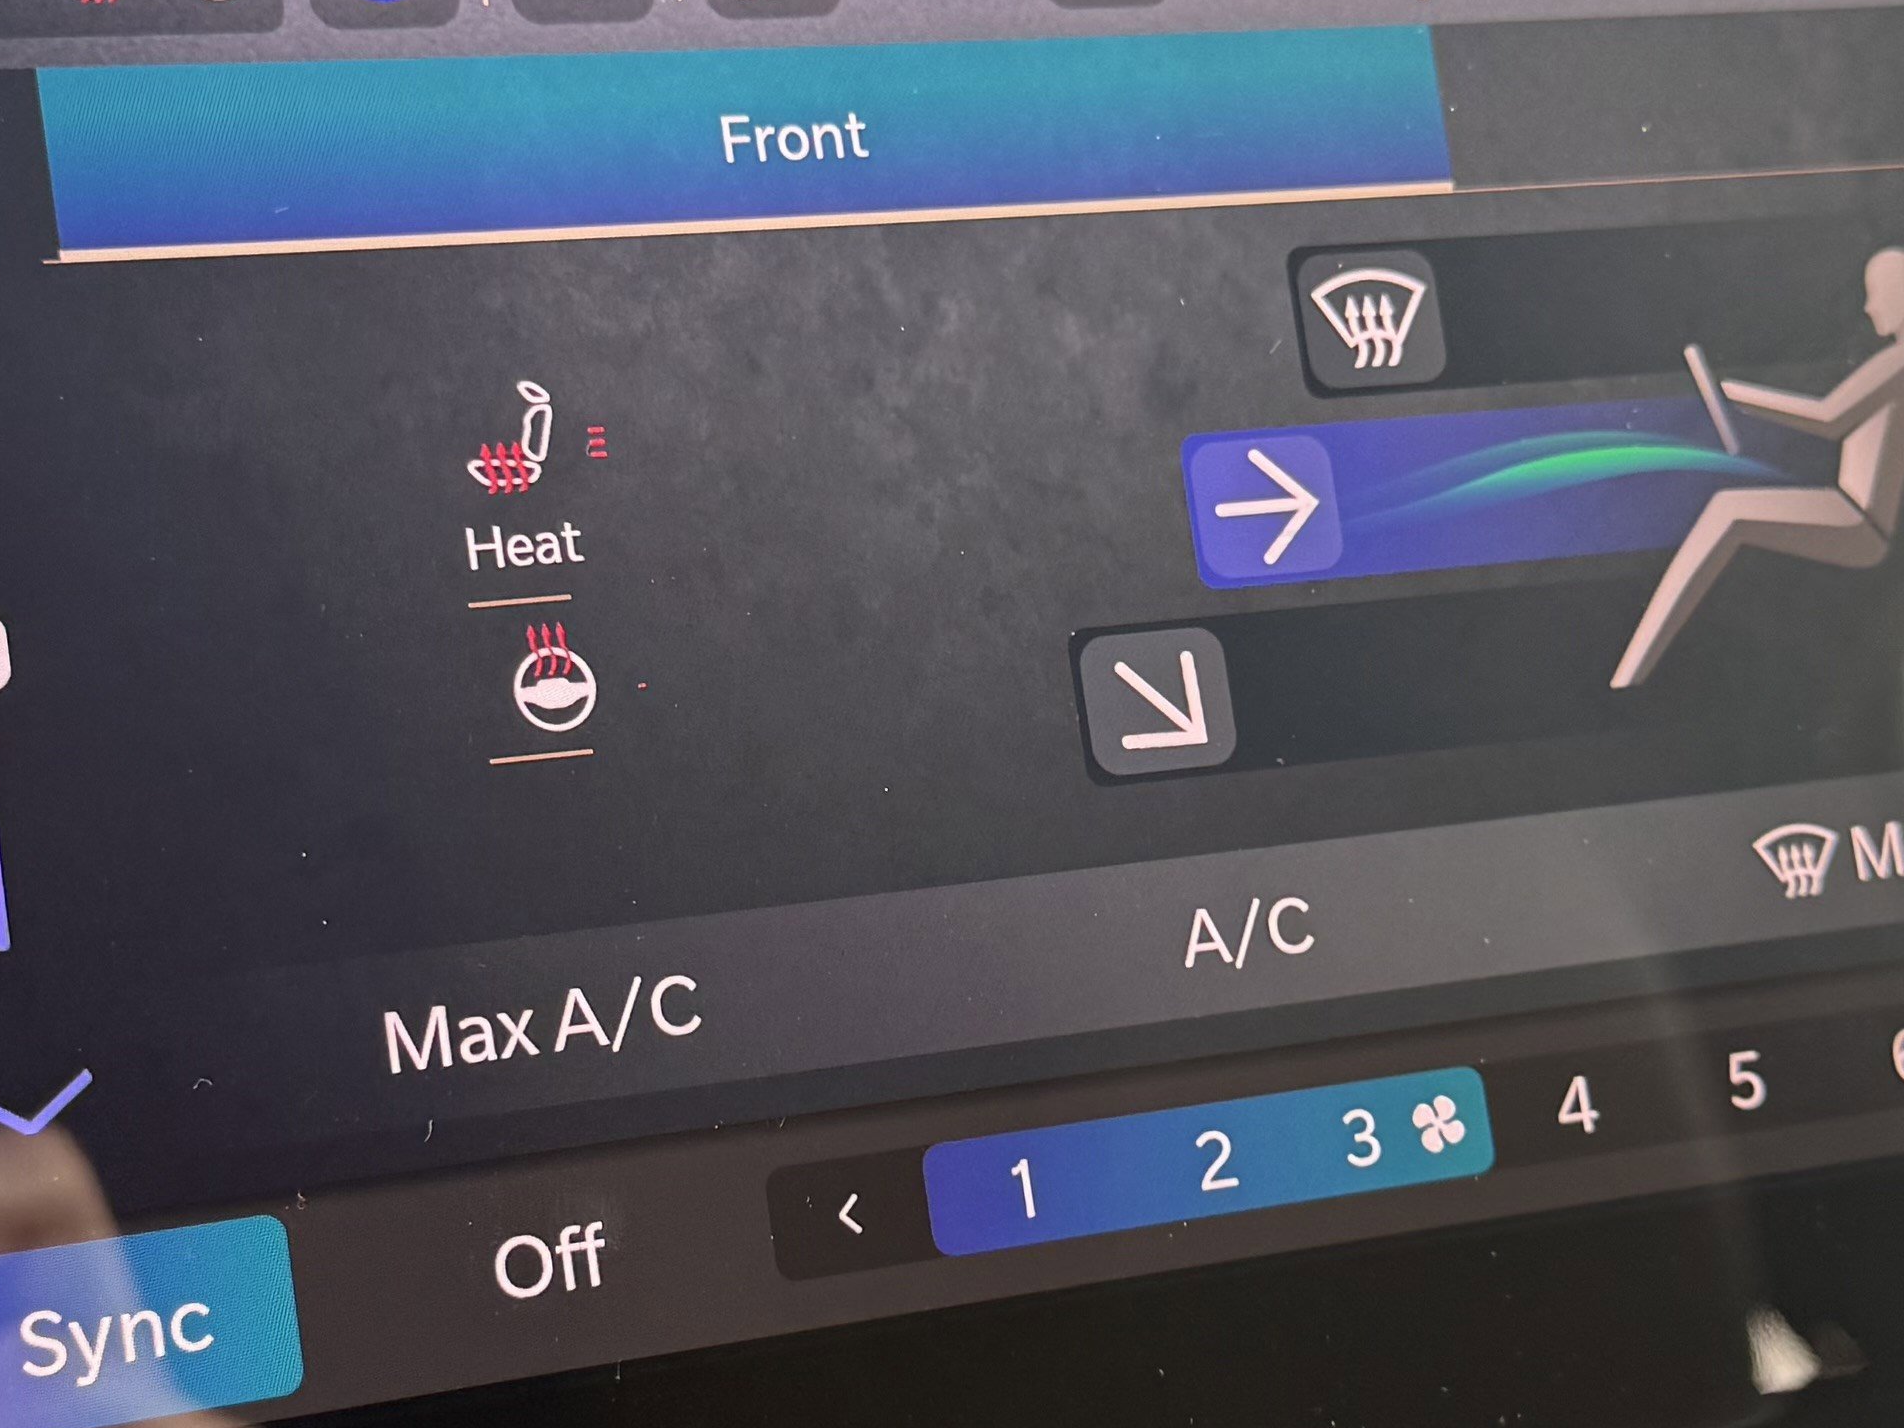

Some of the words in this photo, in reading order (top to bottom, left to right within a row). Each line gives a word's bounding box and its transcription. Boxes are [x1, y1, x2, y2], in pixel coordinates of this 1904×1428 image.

[716, 109, 871, 168] Front
[464, 521, 585, 571] Heat
[1184, 896, 1315, 970] A/C
[382, 1006, 540, 1075] Max
[553, 974, 703, 1053] A/C
[1010, 1158, 1037, 1219] 1
[1195, 1129, 1240, 1192] 2
[1341, 1108, 1383, 1168] 3
[1556, 1075, 1600, 1134] 4
[1727, 1050, 1767, 1110] 5
[494, 1219, 606, 1299] Off
[19, 1298, 215, 1388] Sync
